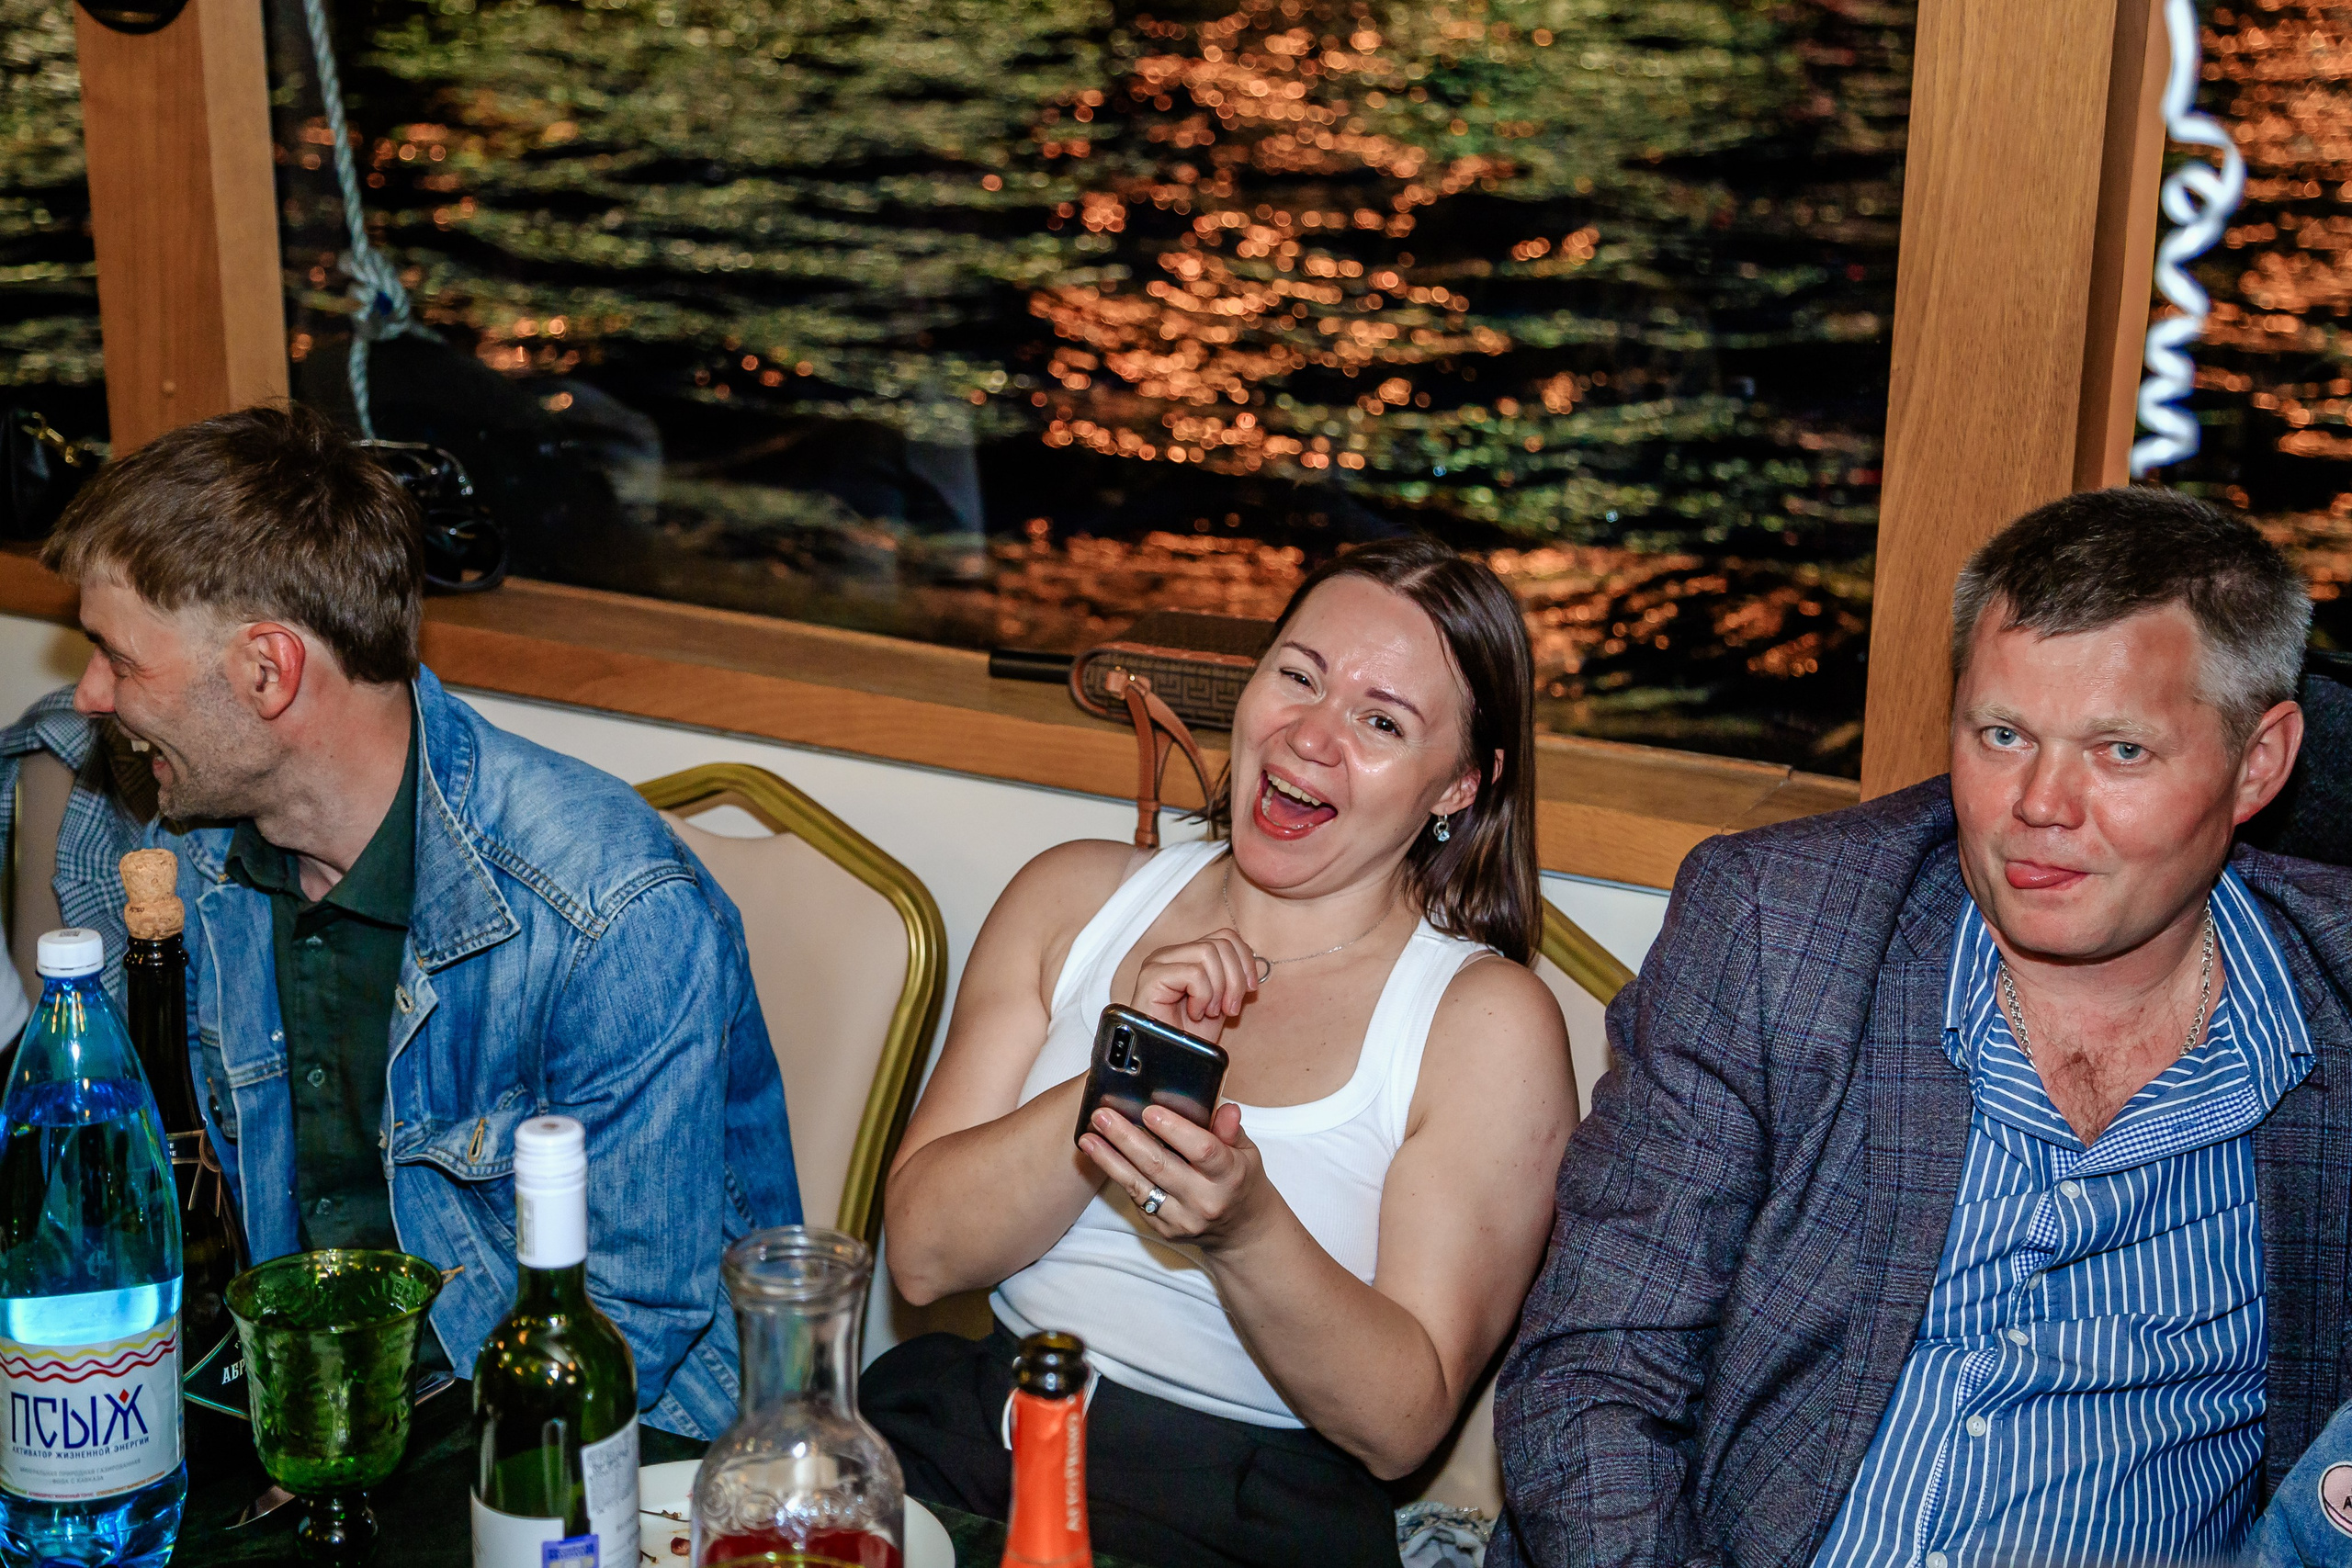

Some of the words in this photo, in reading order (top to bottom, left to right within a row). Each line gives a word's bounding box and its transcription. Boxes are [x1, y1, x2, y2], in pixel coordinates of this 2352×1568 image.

[221, 1358, 247, 1385] АБР
[10, 1384, 149, 1450] ПСЫЖ
[12, 1446, 53, 1459] АКТИВАТОР
[55, 1447, 111, 1460] ЖИЗНЕННОЙ
[113, 1436, 150, 1453] ЭНЕРГИИ
